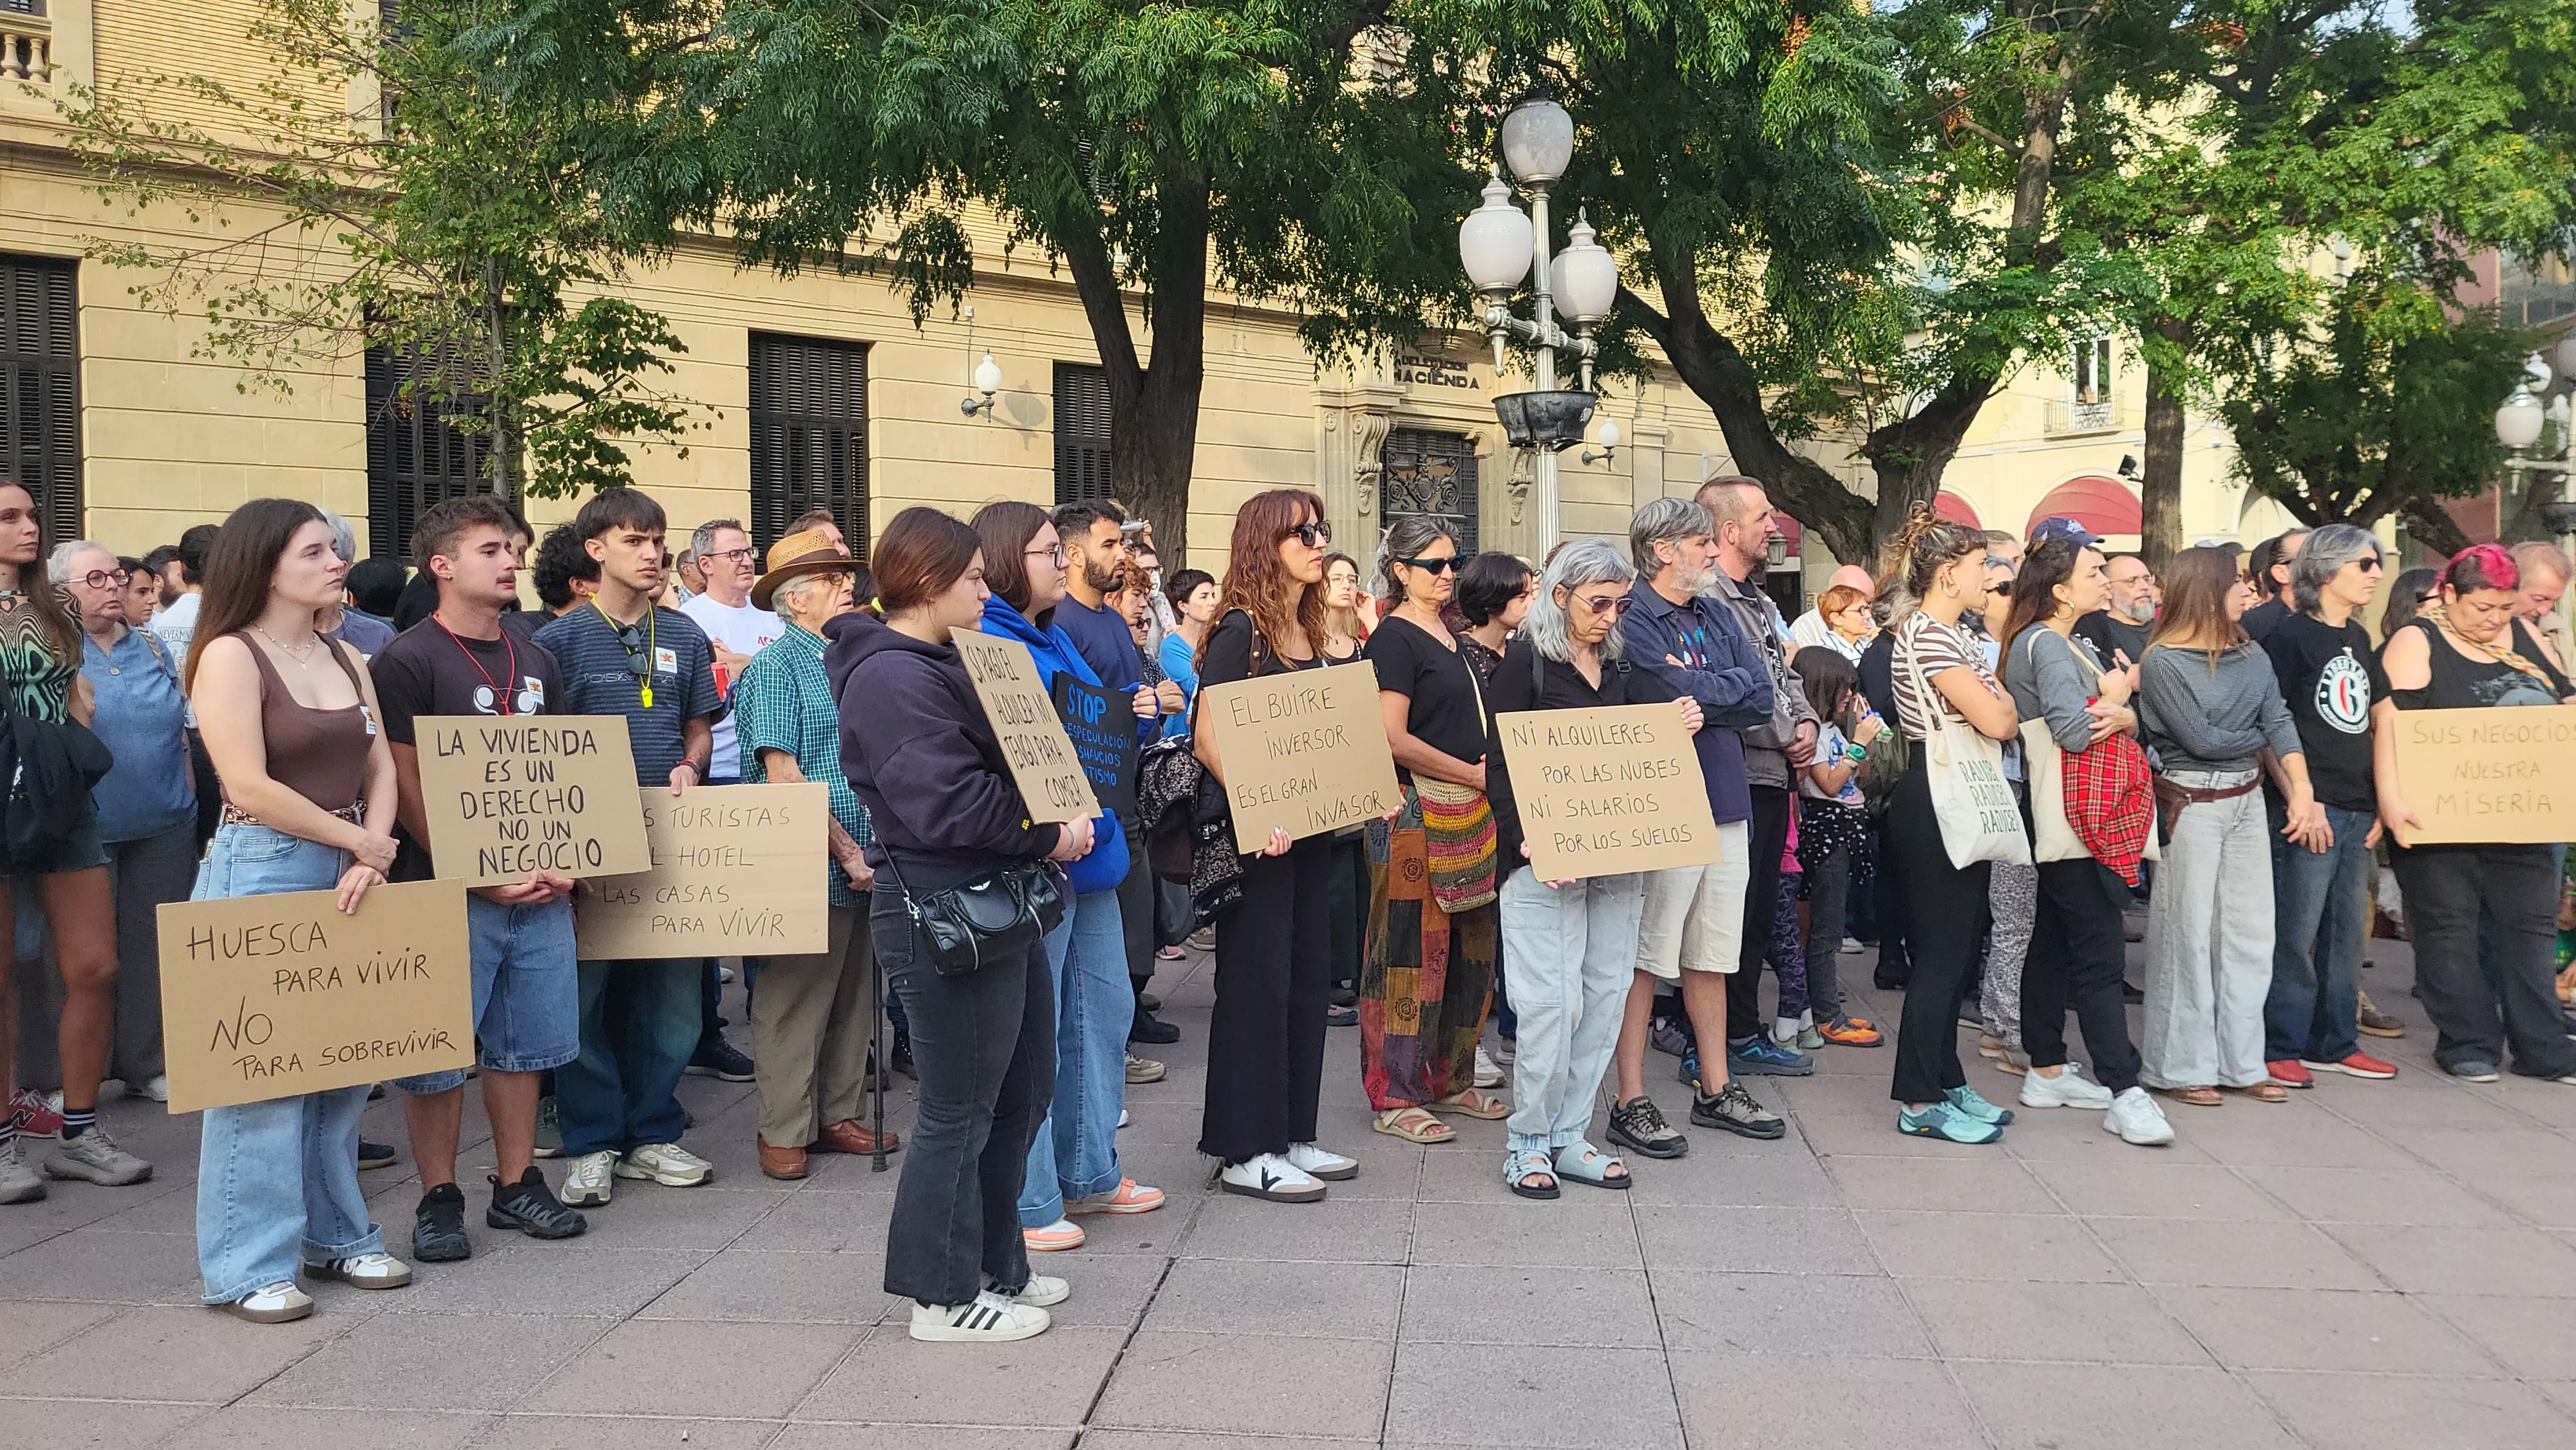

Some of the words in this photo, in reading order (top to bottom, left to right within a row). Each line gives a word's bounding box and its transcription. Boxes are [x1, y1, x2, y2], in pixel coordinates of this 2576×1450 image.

[1394, 368, 1480, 390] HACIENDA
[975, 646, 1006, 683] PAGO
[998, 648, 1019, 681] EL
[990, 692, 1039, 726] ALQUILER
[1032, 692, 1052, 725] NO
[1067, 683, 1106, 726] STOP
[1230, 696, 1261, 727] EL
[437, 728, 466, 757] LA
[480, 727, 598, 757] VIVIENDA
[2412, 720, 2461, 744] SUS
[1003, 733, 1039, 770] TENGO
[1033, 735, 1068, 766] PARA
[1075, 744, 1121, 767] SHAUCIOS
[485, 759, 511, 783] ES
[526, 760, 554, 783] UN
[1541, 765, 1577, 784] POR
[1580, 764, 1613, 783] LAS
[1620, 758, 1681, 782] NUBES
[460, 785, 585, 820] DERECHO
[1045, 774, 1088, 808] COMER
[1236, 784, 1257, 809] ES
[1260, 784, 1279, 804] EL
[1282, 767, 1318, 800] GRAN
[498, 818, 529, 841] NO
[542, 820, 572, 840] UN
[643, 807, 654, 827] S
[1553, 832, 1591, 853] POR
[1592, 830, 1622, 850] LOS
[1630, 824, 1692, 848] SUELOS
[478, 838, 602, 878] NEGOCIO
[651, 846, 664, 865] L
[677, 845, 755, 867] HOTEL
[603, 881, 641, 905] LAS
[656, 884, 730, 903] CASAS
[651, 914, 705, 934] PARA
[185, 921, 328, 962] HUESCA
[272, 965, 343, 995] PARA
[210, 995, 273, 1052] NO
[232, 1053, 304, 1080] PARA
